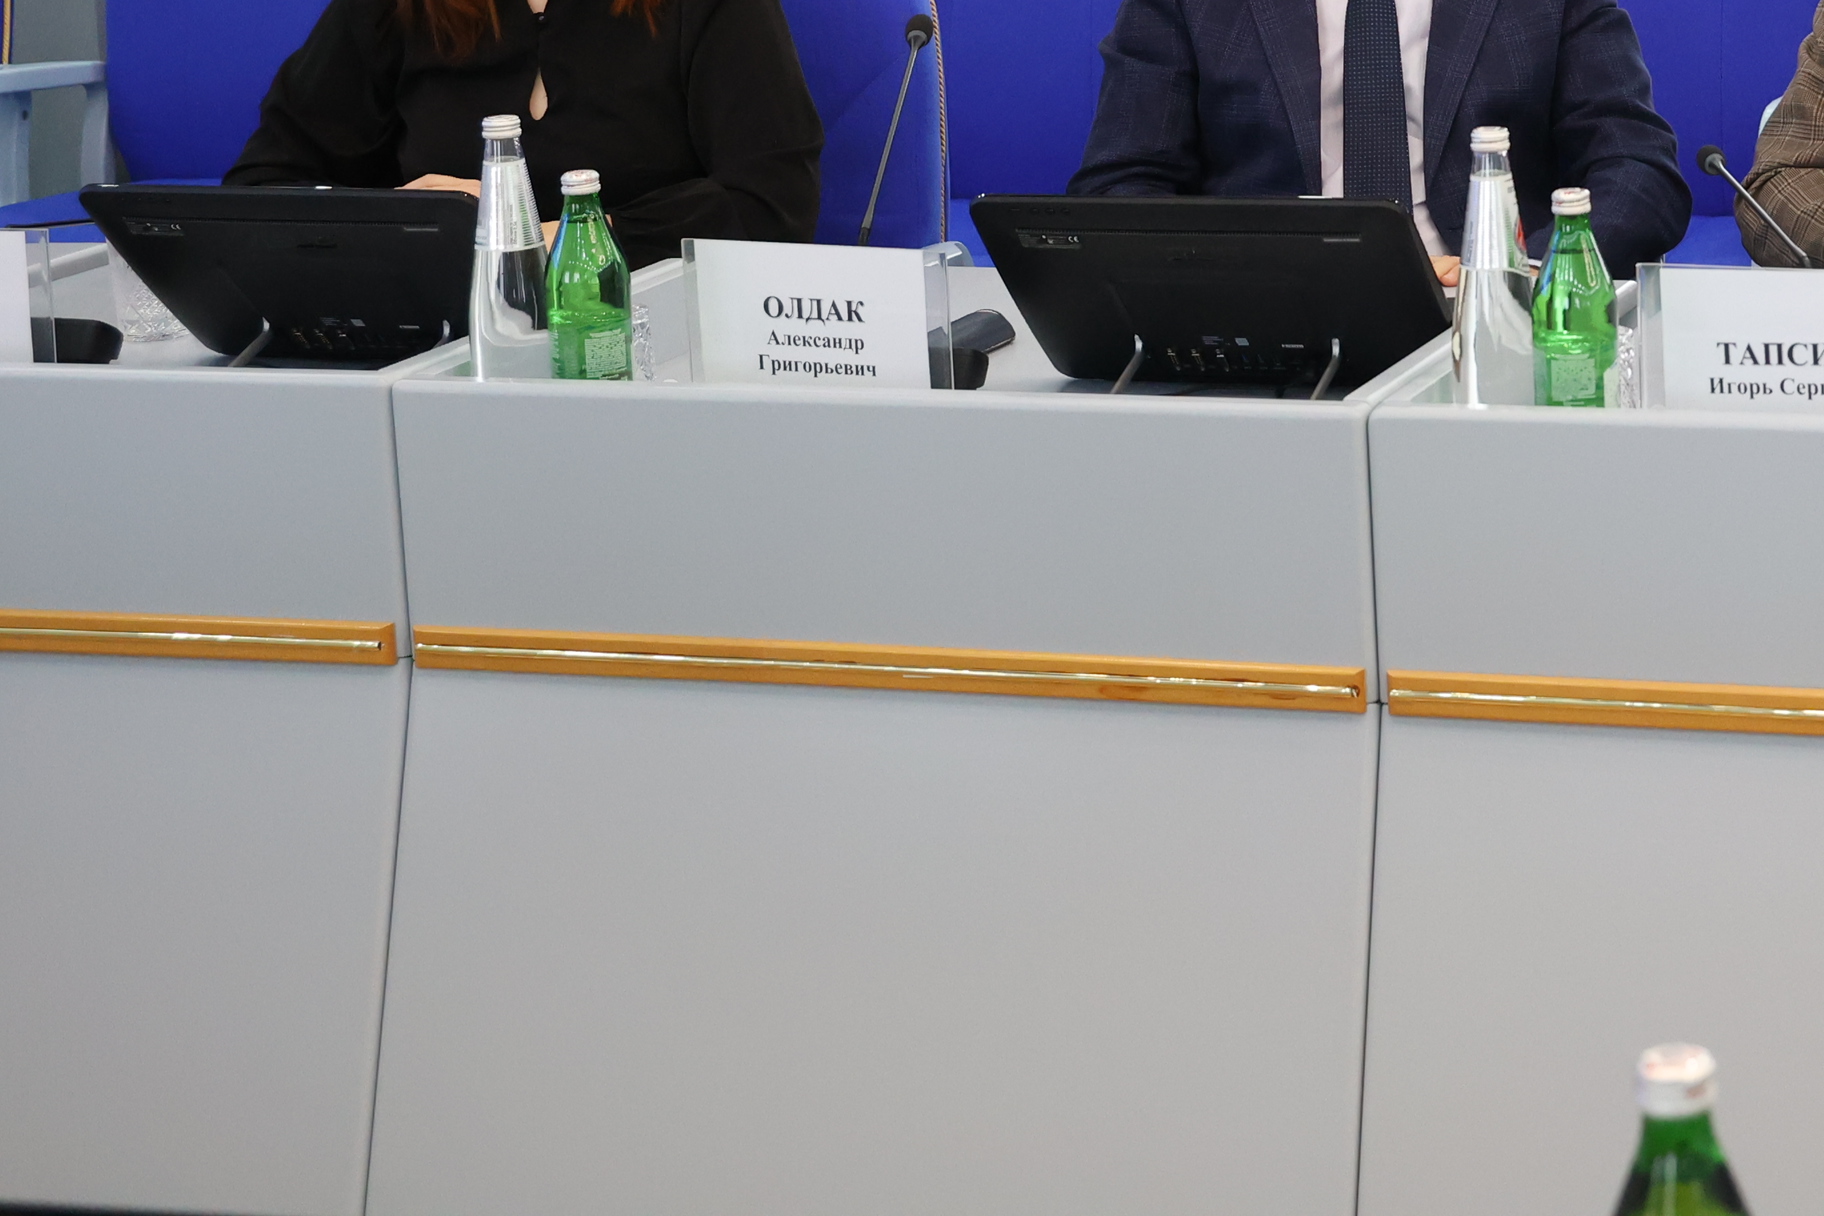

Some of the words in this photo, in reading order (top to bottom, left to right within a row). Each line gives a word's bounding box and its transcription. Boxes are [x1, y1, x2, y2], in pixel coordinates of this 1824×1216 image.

[763, 295, 866, 325] ОЛДАК
[766, 329, 865, 355] Александр
[758, 353, 877, 379] Григорьевич
[1709, 376, 1773, 400] Игорь
